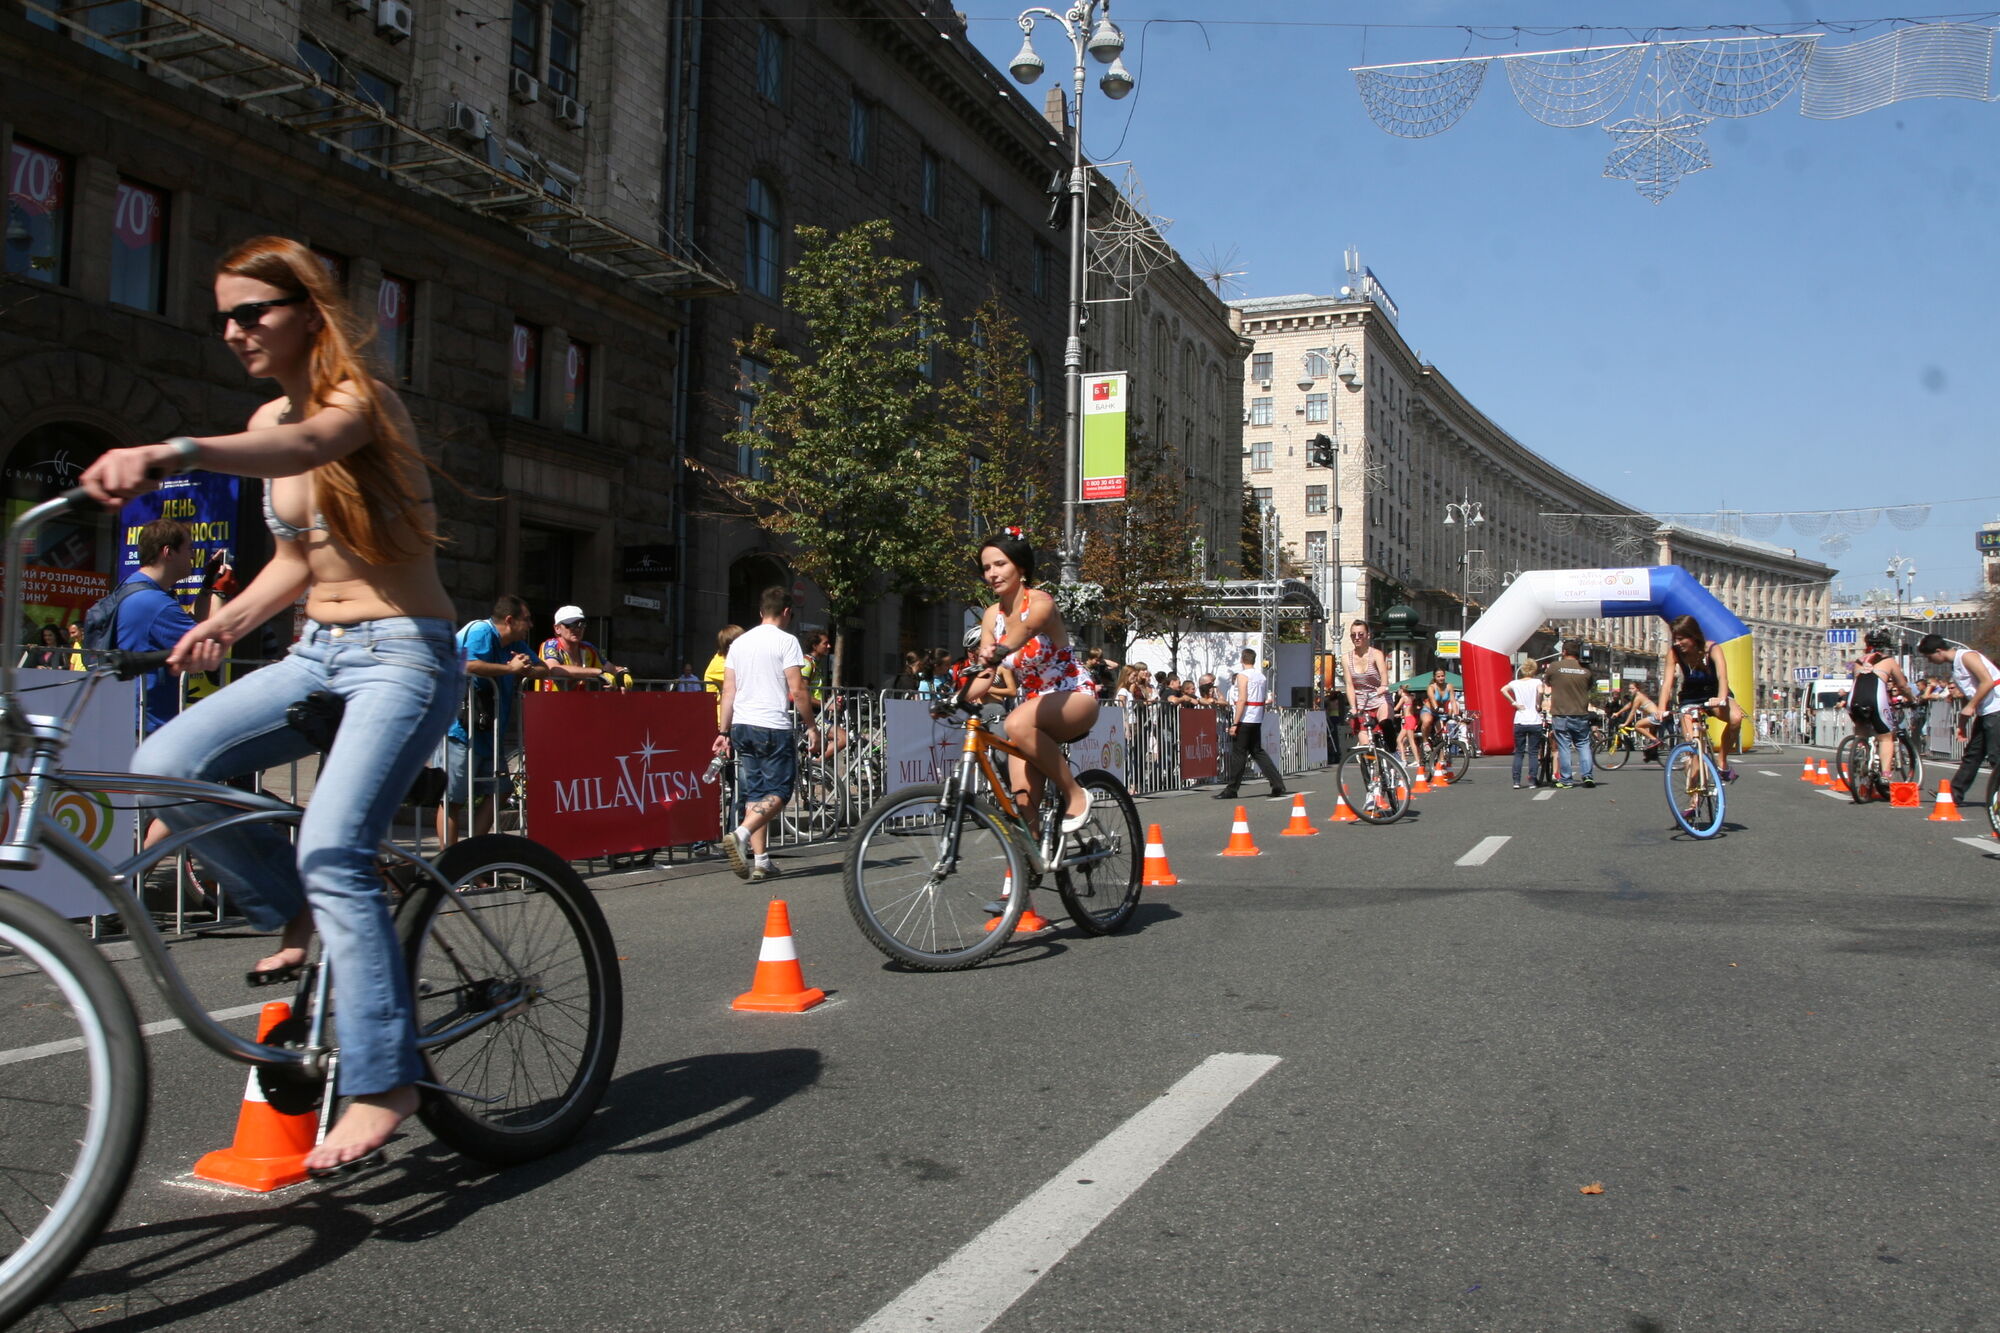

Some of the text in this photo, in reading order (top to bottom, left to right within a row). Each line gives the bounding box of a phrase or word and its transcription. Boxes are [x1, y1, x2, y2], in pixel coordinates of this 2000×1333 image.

[115, 184, 160, 235] 70%
[1096, 403, 1115, 411] БАНК
[6, 469, 53, 484] GRAND
[162, 498, 197, 518] ДЕНЬ
[129, 552, 138, 560] 24
[40, 569, 107, 587] РОЗПРОДАЖ
[51, 583, 58, 593] З
[552, 756, 703, 815] MILAVITSA
